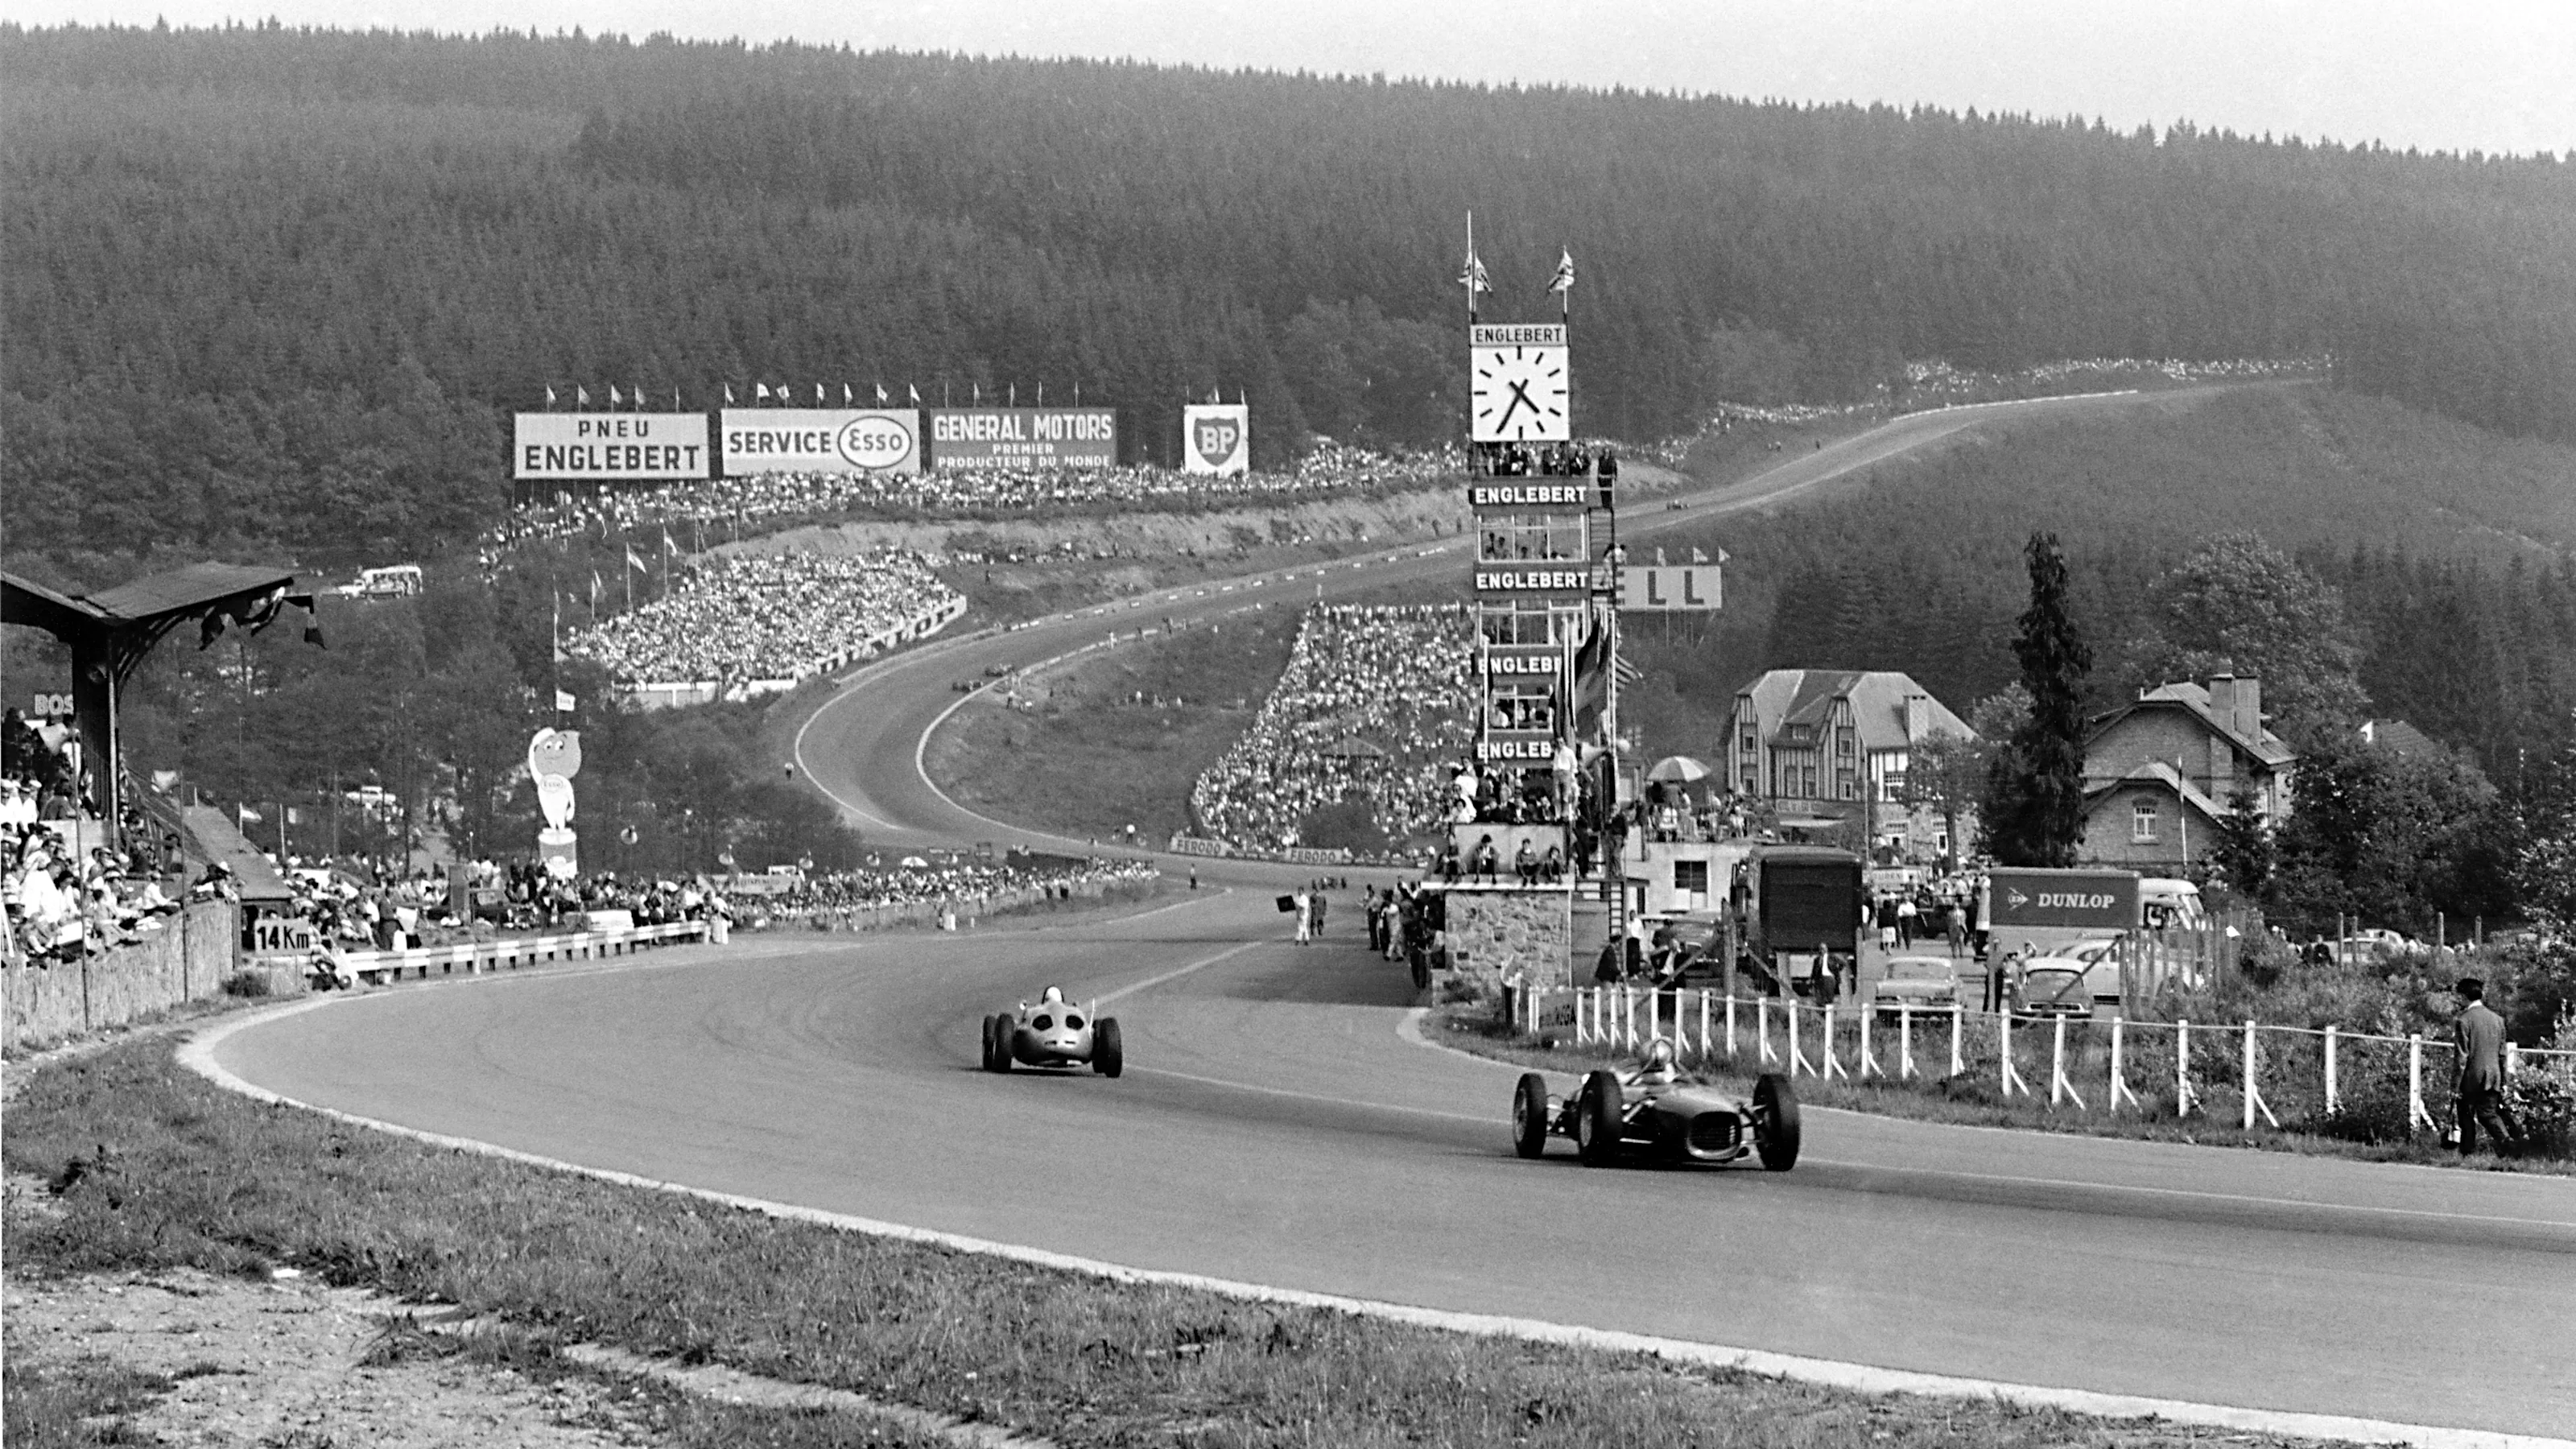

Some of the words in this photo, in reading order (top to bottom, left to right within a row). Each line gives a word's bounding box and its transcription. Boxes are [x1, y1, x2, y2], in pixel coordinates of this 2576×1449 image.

[1476, 328, 1561, 342] ENGLEBERT
[578, 420, 649, 437] PNEU
[934, 415, 1026, 440] GENERAL
[1034, 414, 1112, 440] MOTORS
[729, 431, 831, 453] SERVICE
[848, 428, 902, 451] Esso
[1199, 426, 1236, 454] BP
[525, 445, 699, 471] ENGLEBERT
[993, 444, 1054, 455] PREMIER
[938, 456, 1030, 469] PRODUCTEUR
[1038, 456, 1056, 468] DU
[1064, 456, 1110, 468] MONDE
[1475, 486, 1587, 504] ENGLEBERT
[1476, 572, 1588, 589] ENGLEBERT
[1290, 849, 1336, 863] FERODO
[2038, 893, 2115, 909] DUNLOP
[257, 926, 280, 950] 14
[283, 926, 309, 949] Km
